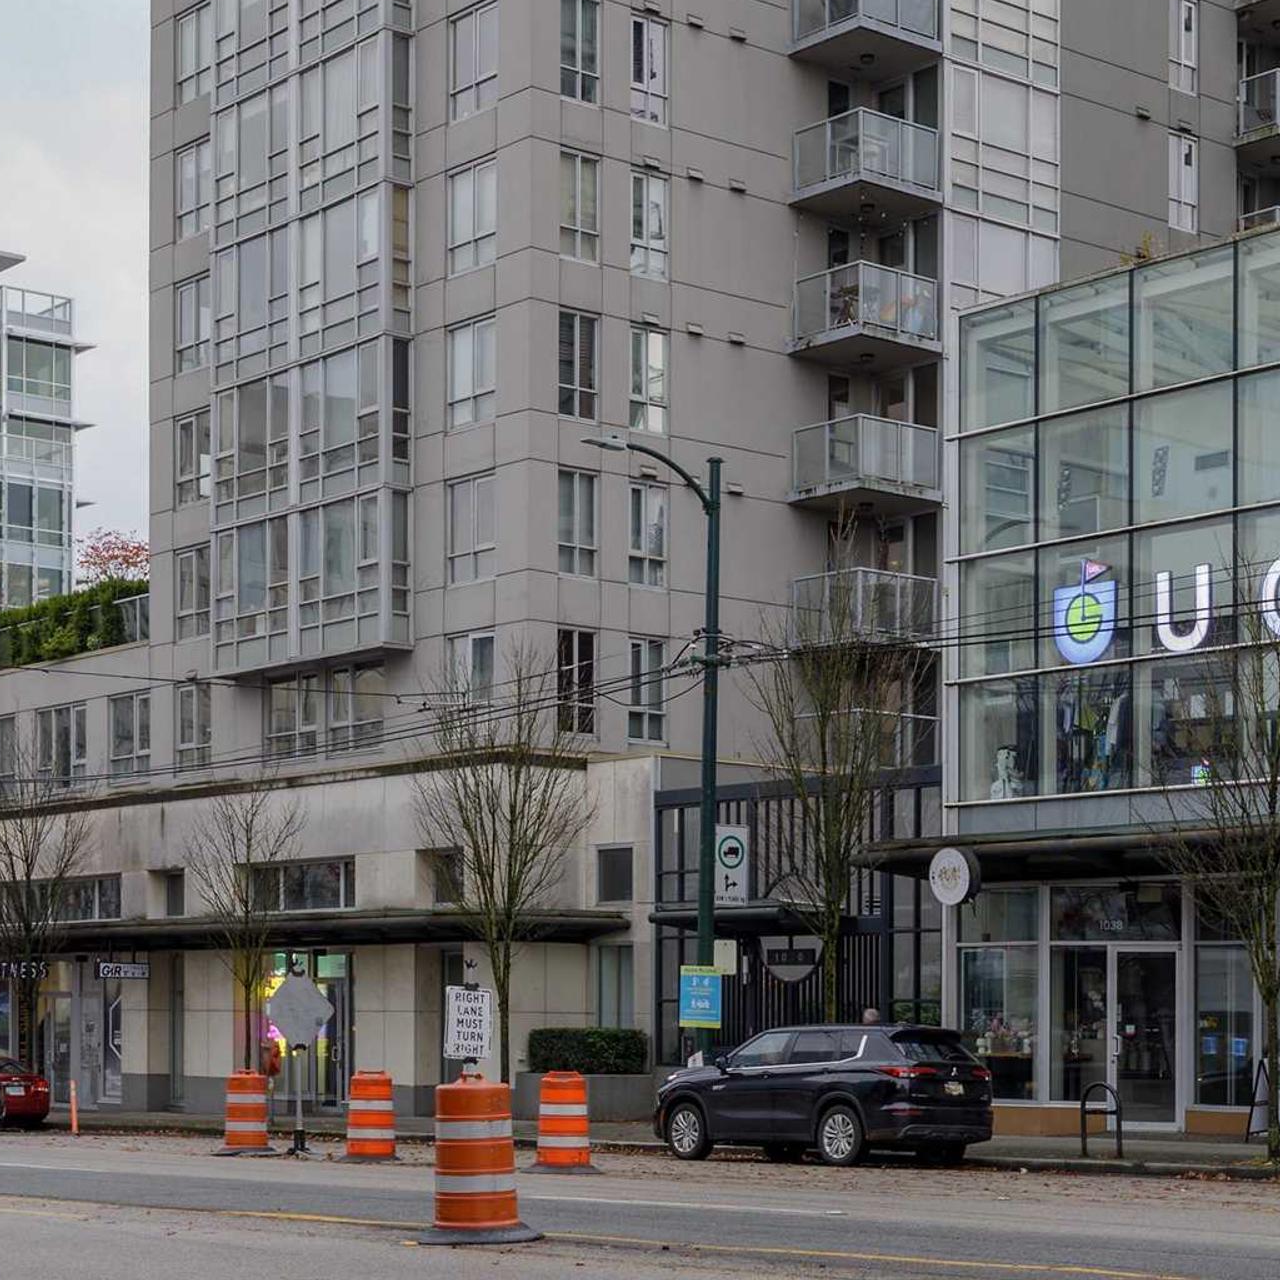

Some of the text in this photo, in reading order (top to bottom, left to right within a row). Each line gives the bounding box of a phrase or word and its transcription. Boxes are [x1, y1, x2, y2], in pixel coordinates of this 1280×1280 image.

[455, 992, 485, 1004] RIGHT
[457, 1005, 483, 1017] LANE
[456, 1018, 483, 1029] MUST
[456, 1031, 484, 1042] TURN
[453, 1042, 485, 1055] RIGHT
